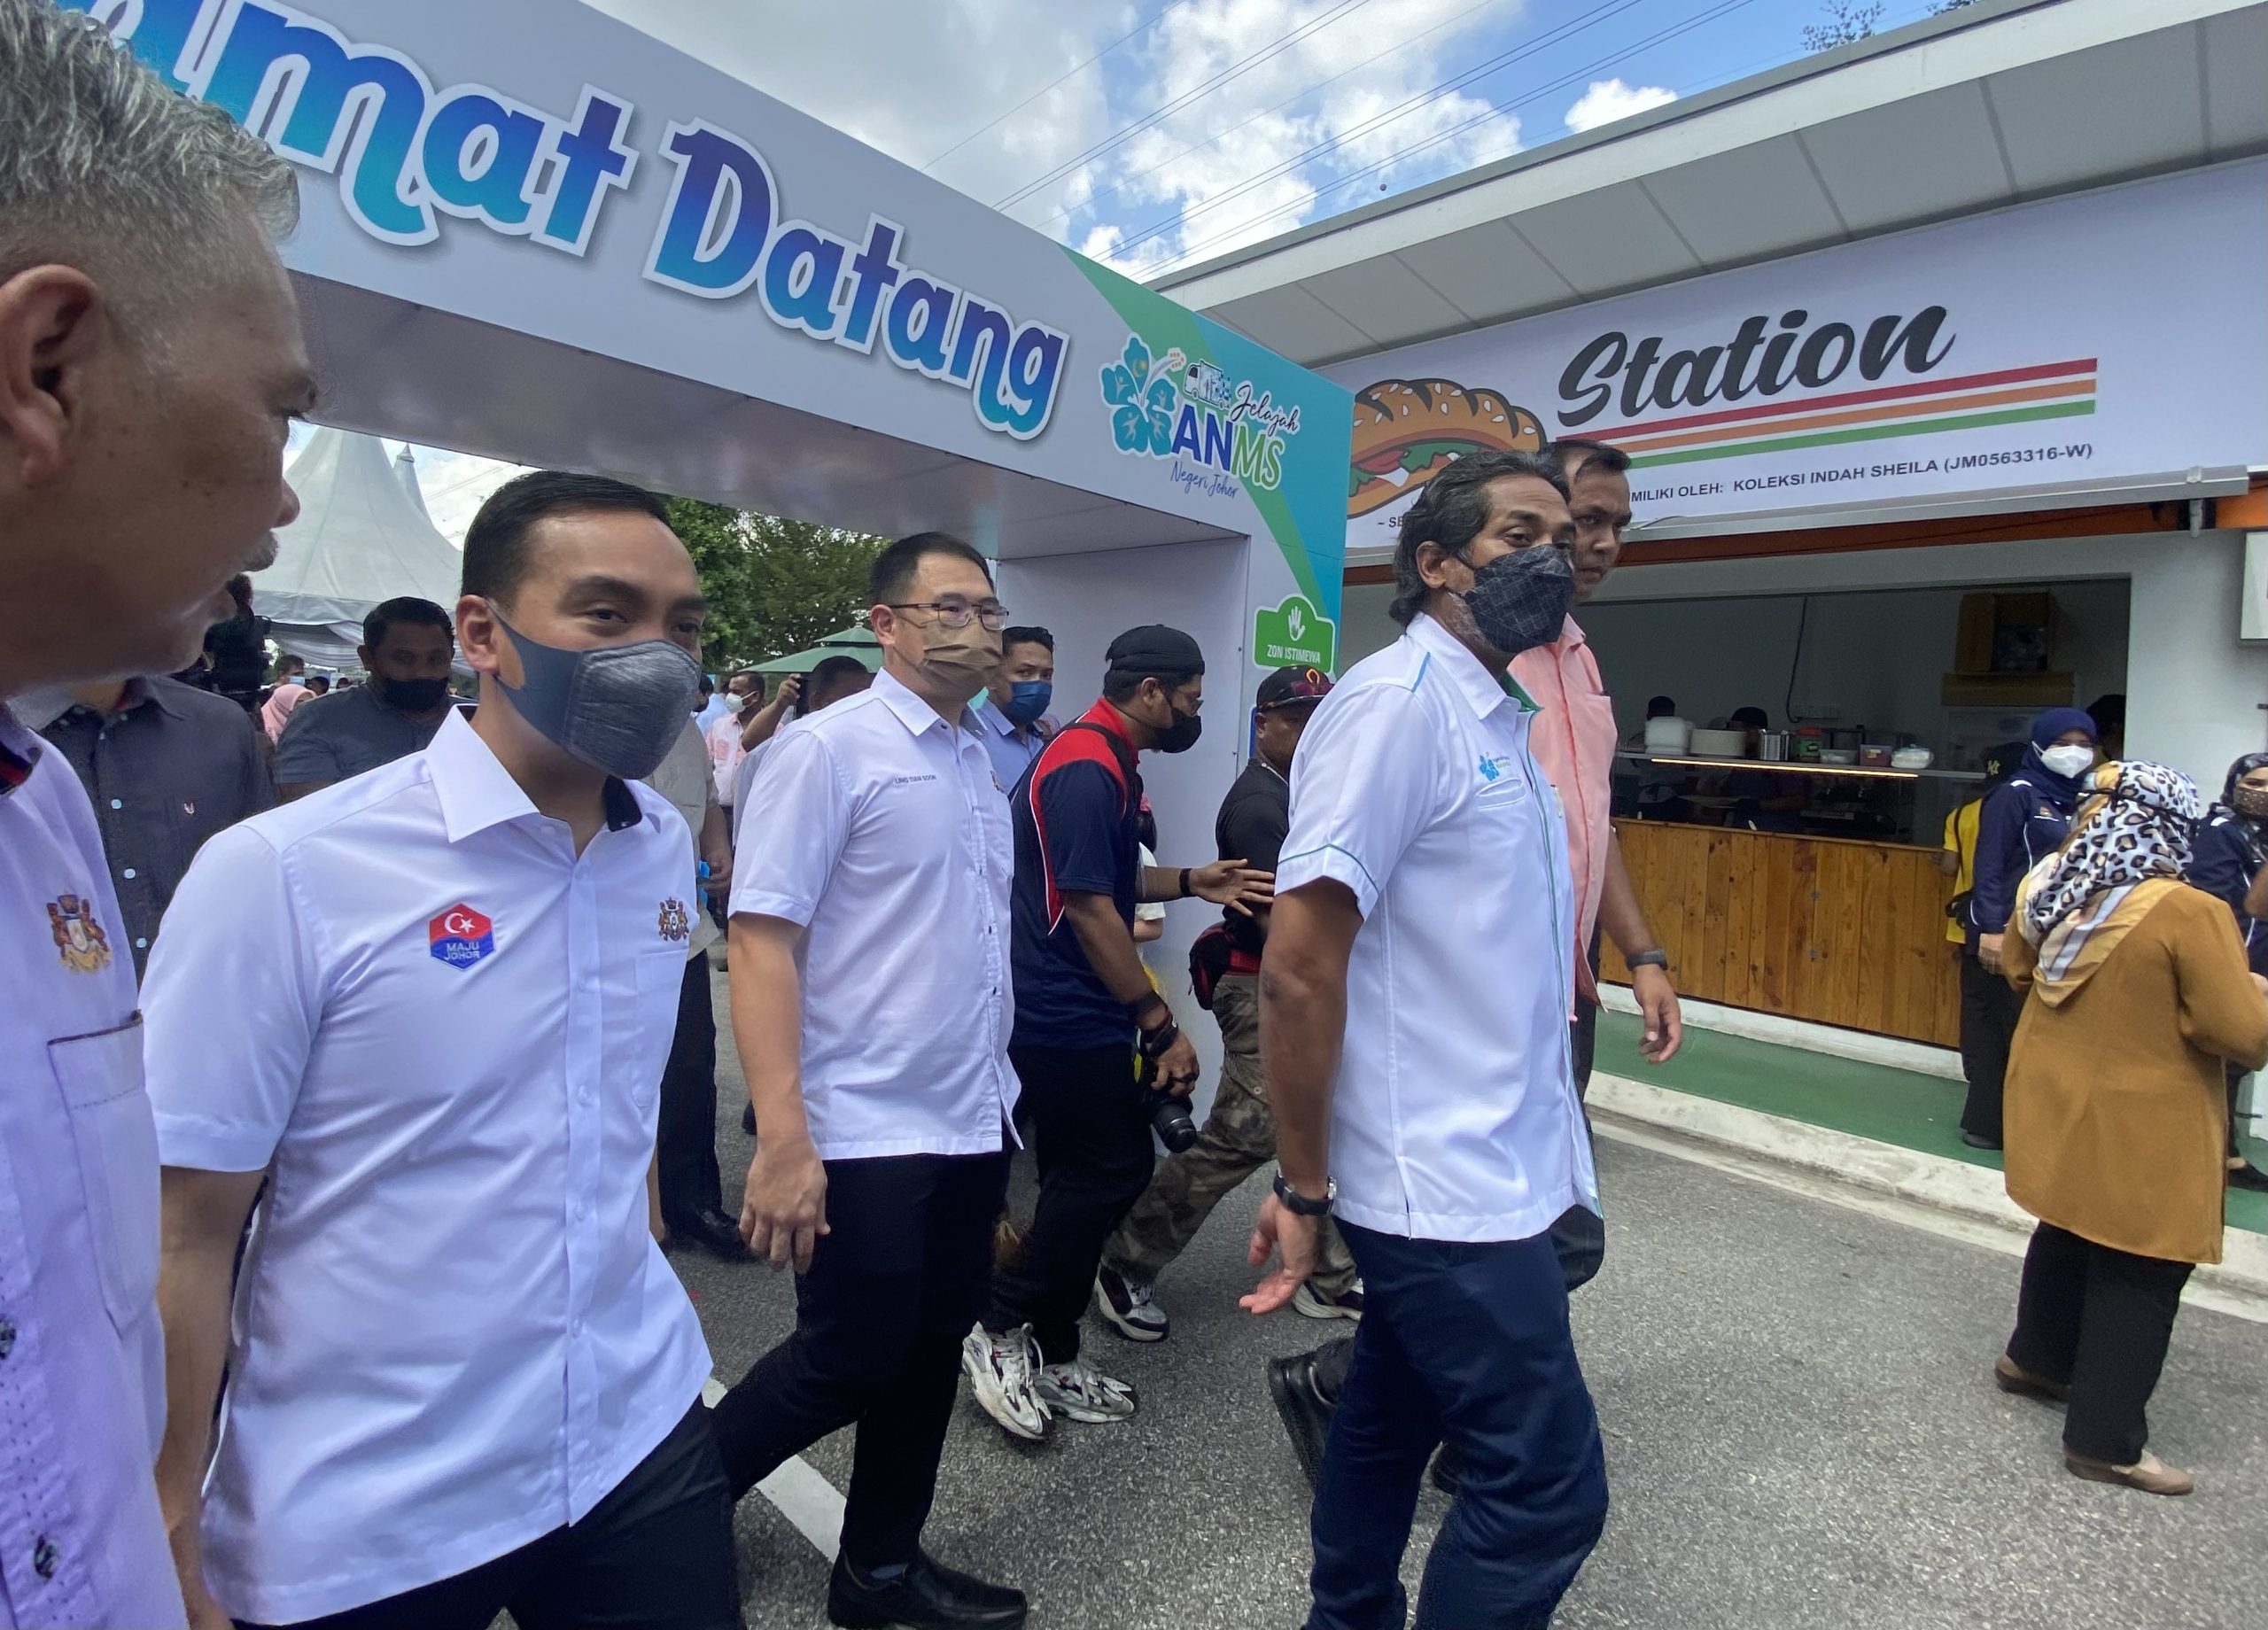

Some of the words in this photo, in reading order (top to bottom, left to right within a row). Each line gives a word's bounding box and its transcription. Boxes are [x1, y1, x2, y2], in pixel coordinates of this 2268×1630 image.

[645, 120, 1068, 438] Datang
[1557, 305, 1956, 428] Station
[1230, 384, 1299, 437] Jelajah
[1170, 403, 1284, 488] ANMS
[1678, 482, 1724, 497] OLEH:
[1733, 473, 1806, 492] KOLEKSI
[1810, 466, 1865, 484] INDAH
[1870, 459, 1939, 478] SHEILA
[1943, 443, 2093, 474] (JM0563316-W)
[1169, 460, 1208, 494] Negeri
[1208, 473, 1239, 499] Johor
[1266, 644, 1284, 659] ZON
[1285, 648, 1321, 664] ISTIMEWA
[443, 950, 480, 960] JOHOR
[446, 941, 480, 952] MAJU
